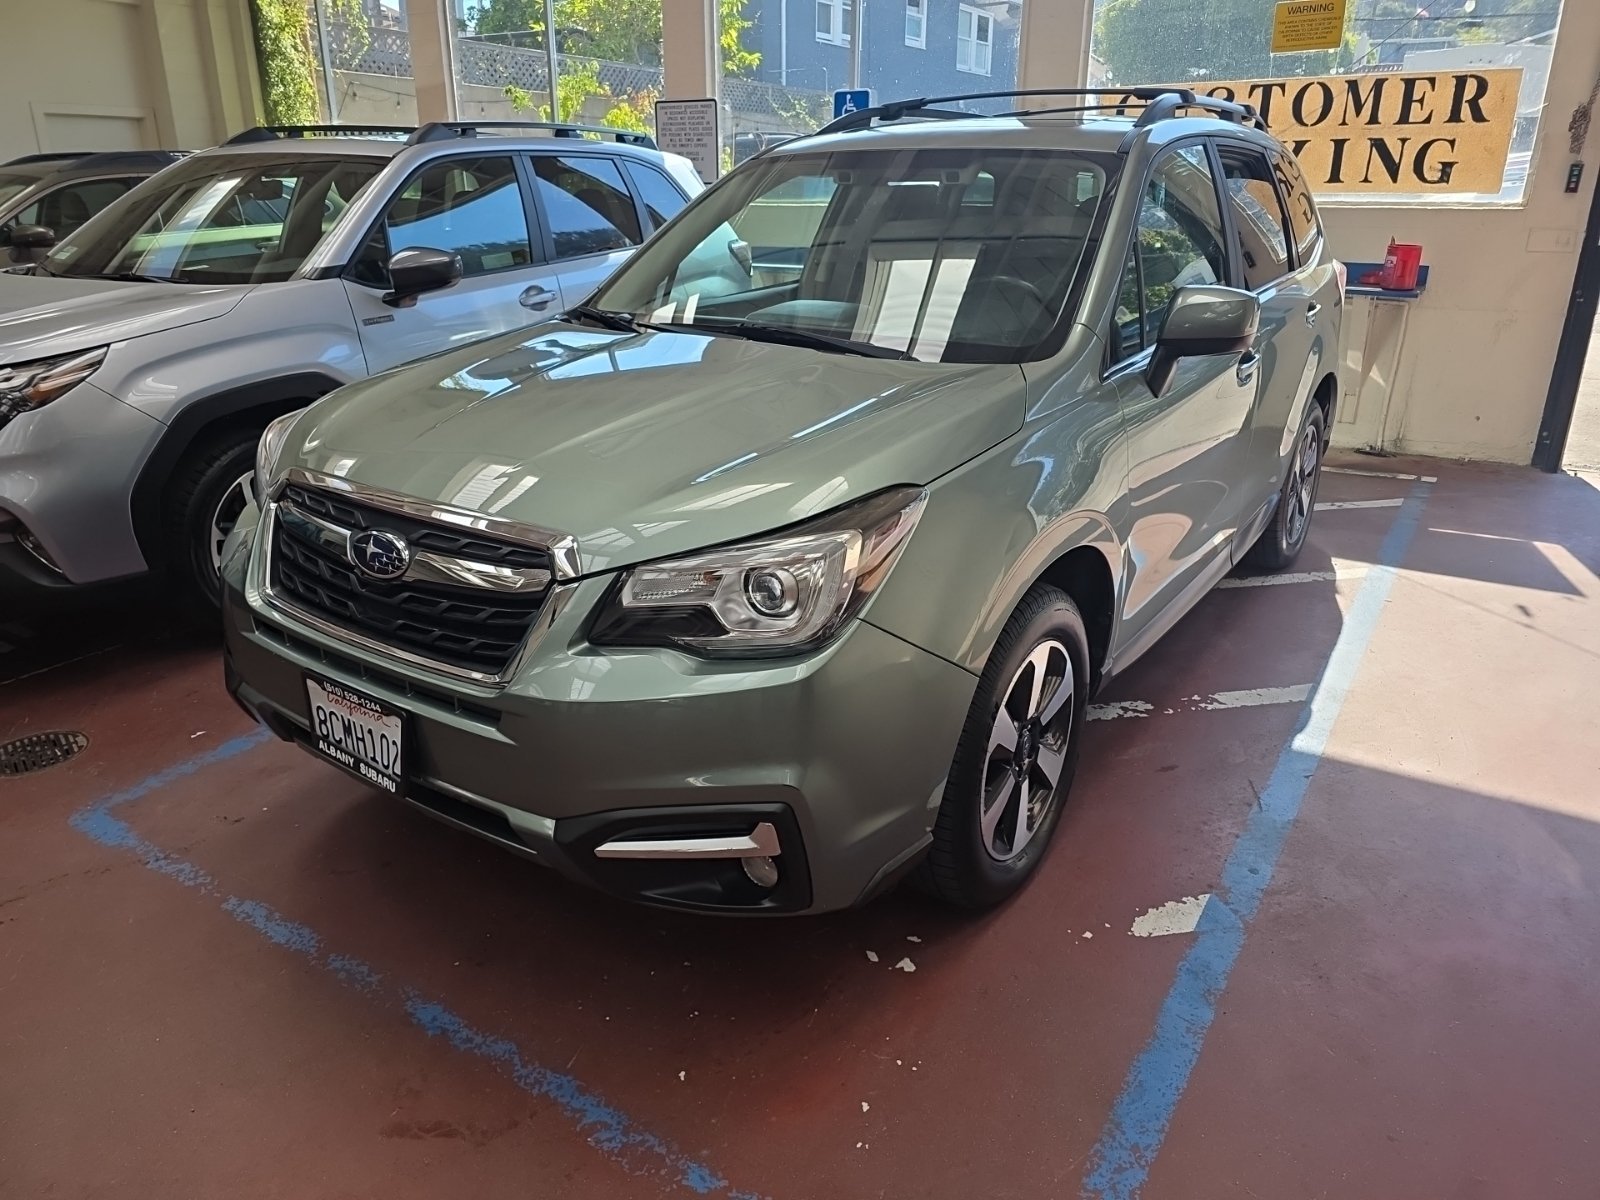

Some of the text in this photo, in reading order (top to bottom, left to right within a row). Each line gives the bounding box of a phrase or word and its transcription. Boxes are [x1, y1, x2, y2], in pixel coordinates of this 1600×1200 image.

[1287, 3, 1335, 15] WARNING
[316, 704, 401, 778] 8CMH102
[319, 739, 395, 793] ALBANY SUBARU
